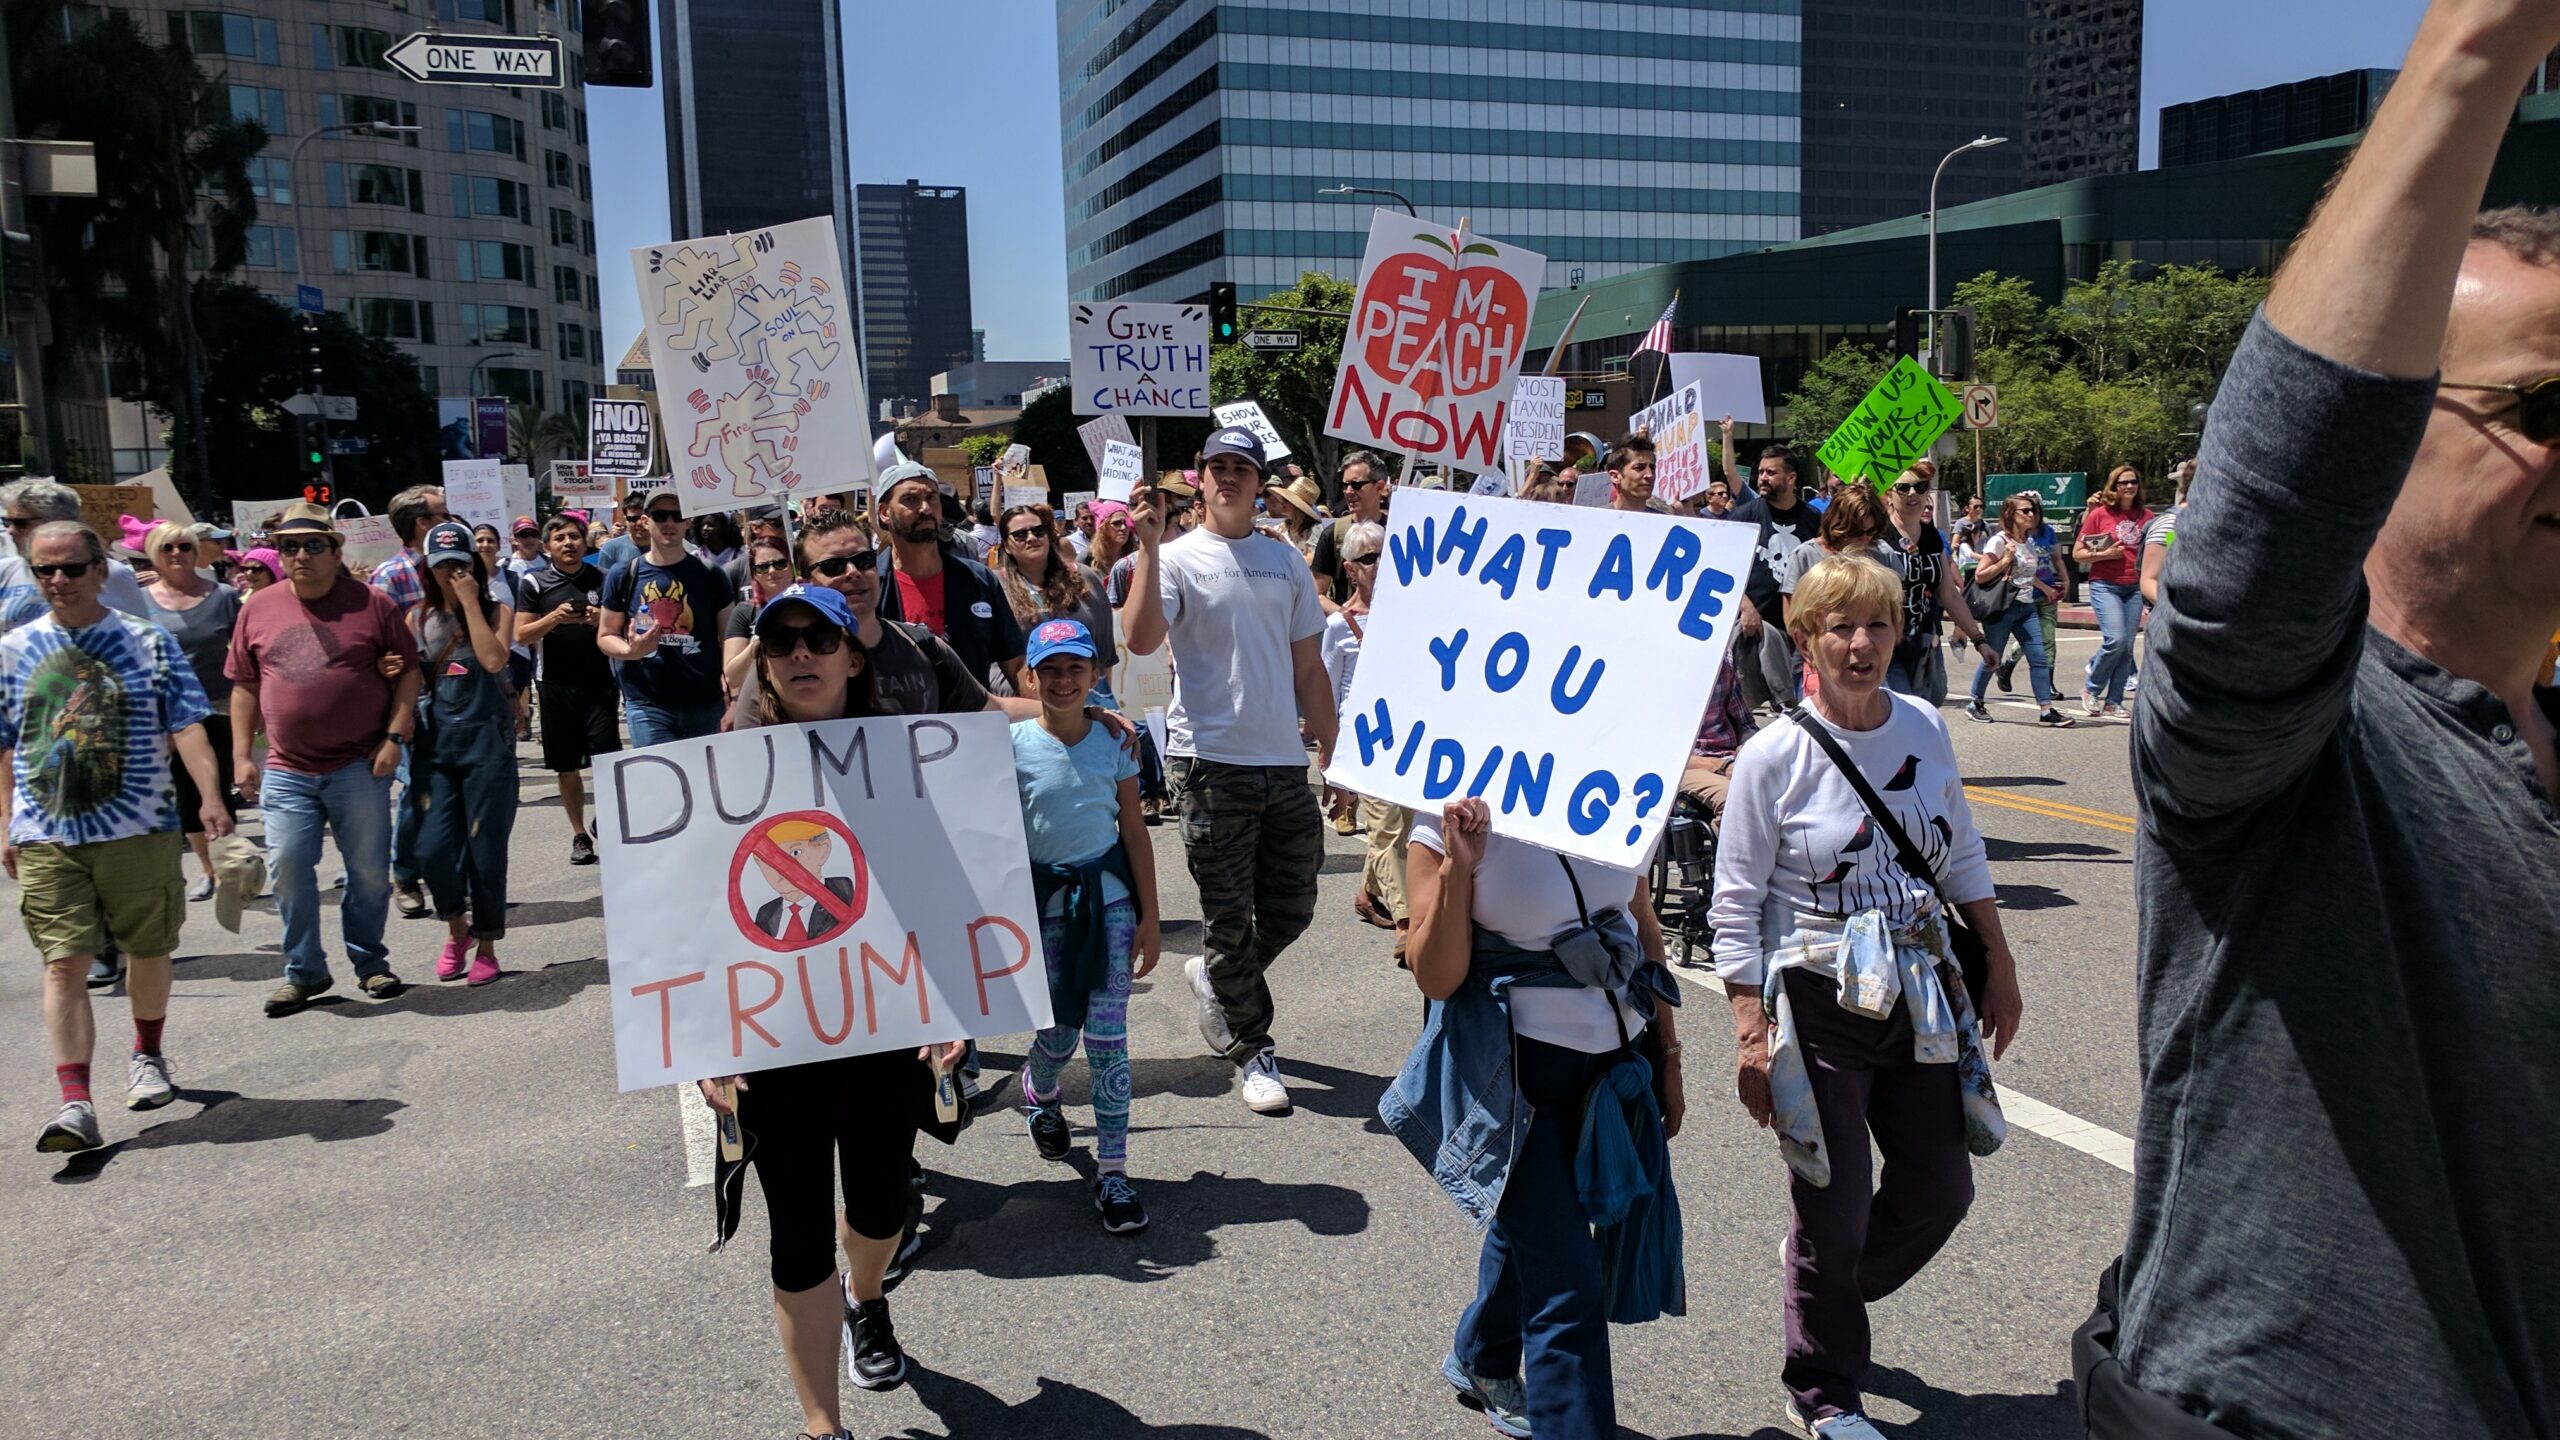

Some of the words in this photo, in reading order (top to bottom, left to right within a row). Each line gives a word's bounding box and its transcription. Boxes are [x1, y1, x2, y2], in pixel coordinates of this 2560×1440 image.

[427, 48, 476, 70] ONE
[494, 51, 544, 72] WAY
[689, 267, 718, 296] LIAR
[702, 275, 729, 301] LIAR
[765, 305, 800, 336] SOUL
[782, 329, 795, 342] ON
[1254, 336, 1271, 345] ONE
[1276, 335, 1295, 345] WAY
[1088, 344, 1202, 372] TRUTH
[1360, 300, 1514, 397] PEACH
[1137, 372, 1157, 385] A
[1514, 378, 1561, 398] MOST
[1093, 387, 1209, 409] CHANCE
[1513, 400, 1564, 420] TAXING
[1586, 395, 1604, 404] DTLA
[594, 404, 649, 432] ¡NO!
[1221, 406, 1259, 424] SHOW
[1332, 364, 1505, 466] NOW
[1825, 403, 1880, 464] SHOW
[1879, 367, 1917, 402] US
[613, 434, 646, 444] BASTA!
[721, 422, 751, 445] Fire
[1510, 420, 1564, 441] PRESIDENT
[1856, 406, 1915, 460] YOUR
[1107, 443, 1127, 455] WHAT
[1128, 449, 1143, 459] ARE
[1513, 440, 1562, 458] EVER
[1657, 443, 1698, 478] PUTIN'S
[1112, 456, 1133, 468] YOU
[1102, 468, 1139, 481] HIDING?
[1659, 464, 1702, 498] PATSY
[1194, 571, 1221, 584] Pray
[1224, 567, 1240, 578] for
[1389, 505, 1572, 601] WHAT
[1587, 524, 1735, 642] ARE
[1429, 628, 1605, 716] YOU
[614, 719, 959, 845] DUMP
[1354, 697, 1664, 848] HIDING?
[630, 915, 1031, 1068] TRUMP
